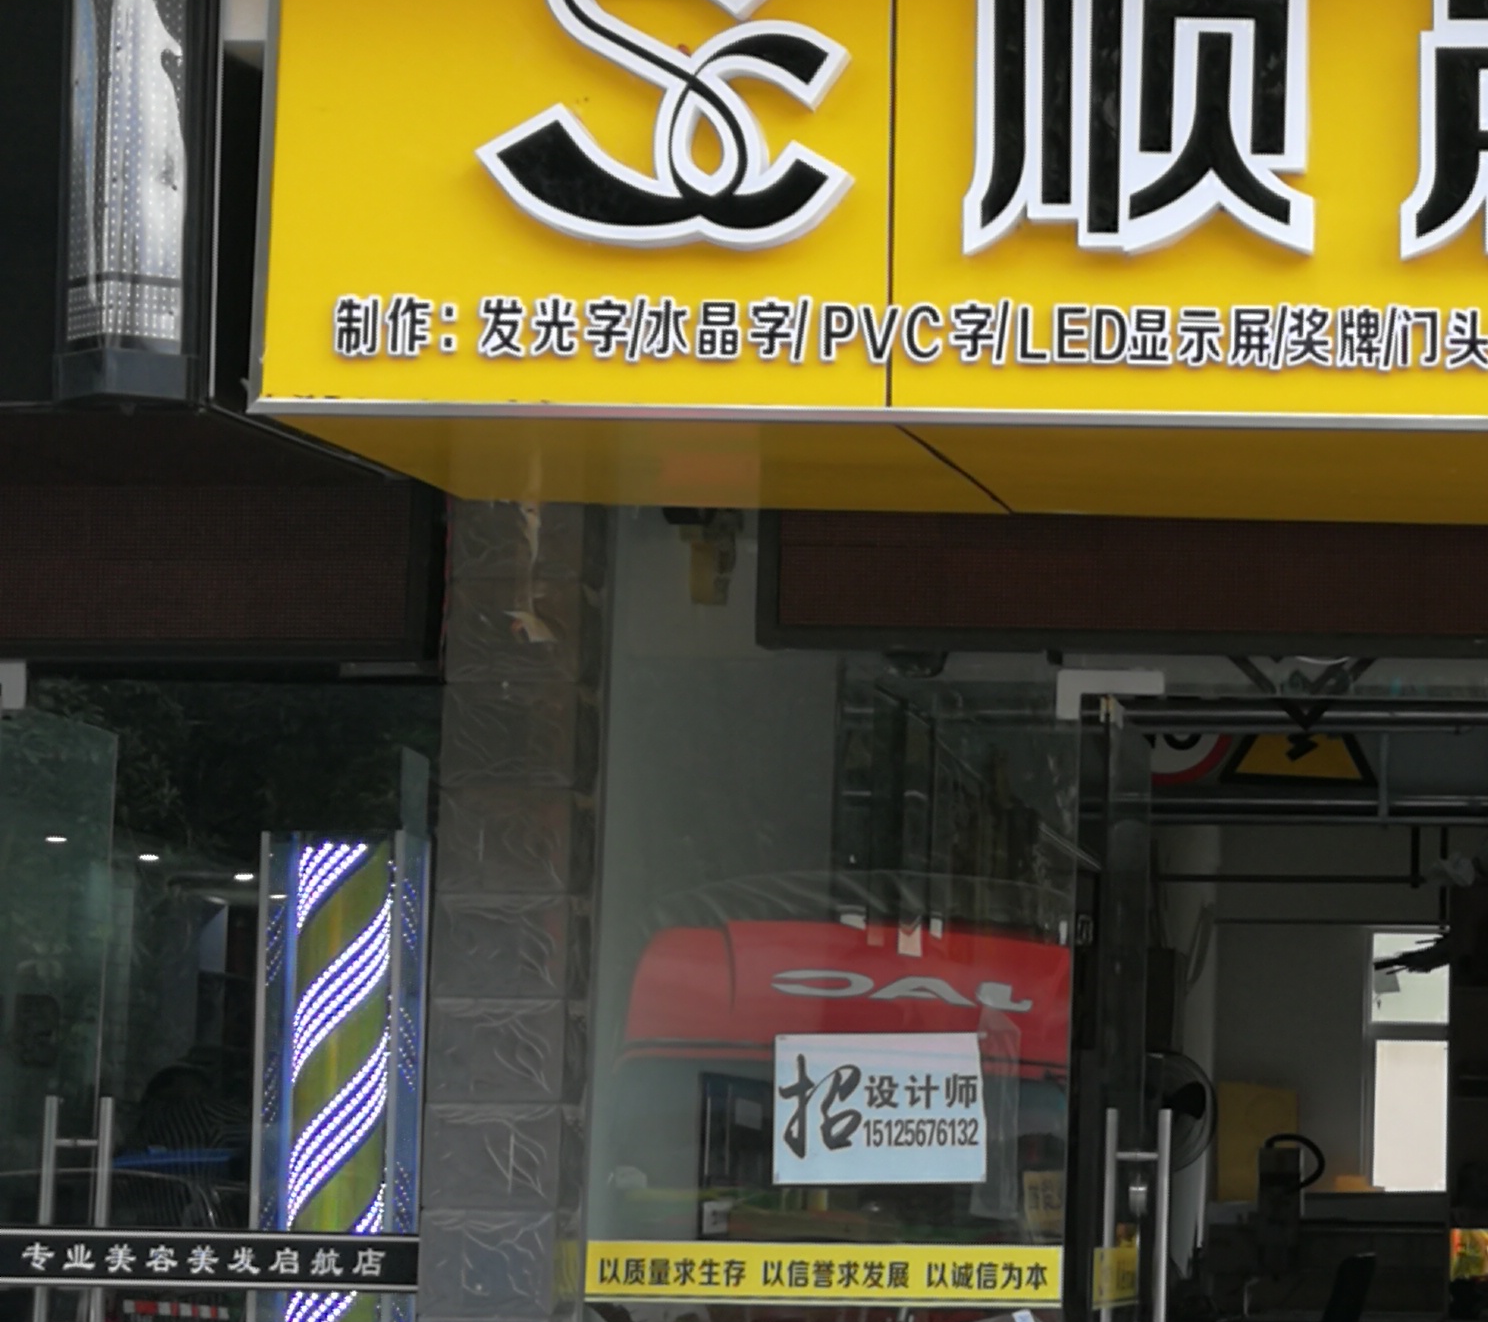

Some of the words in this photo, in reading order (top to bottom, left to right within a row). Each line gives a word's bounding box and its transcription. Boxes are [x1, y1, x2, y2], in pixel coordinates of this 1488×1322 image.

[779, 1052, 862, 1159] 招
[863, 1072, 980, 1110] 设计师
[862, 1117, 980, 1149] 15125676132
[20, 1240, 387, 1278] 专业美容美发启航店
[598, 1256, 747, 1287] 以质量求生存
[761, 1259, 911, 1290] 以信誉求发展
[926, 1260, 1048, 1290] 以诚信为本
